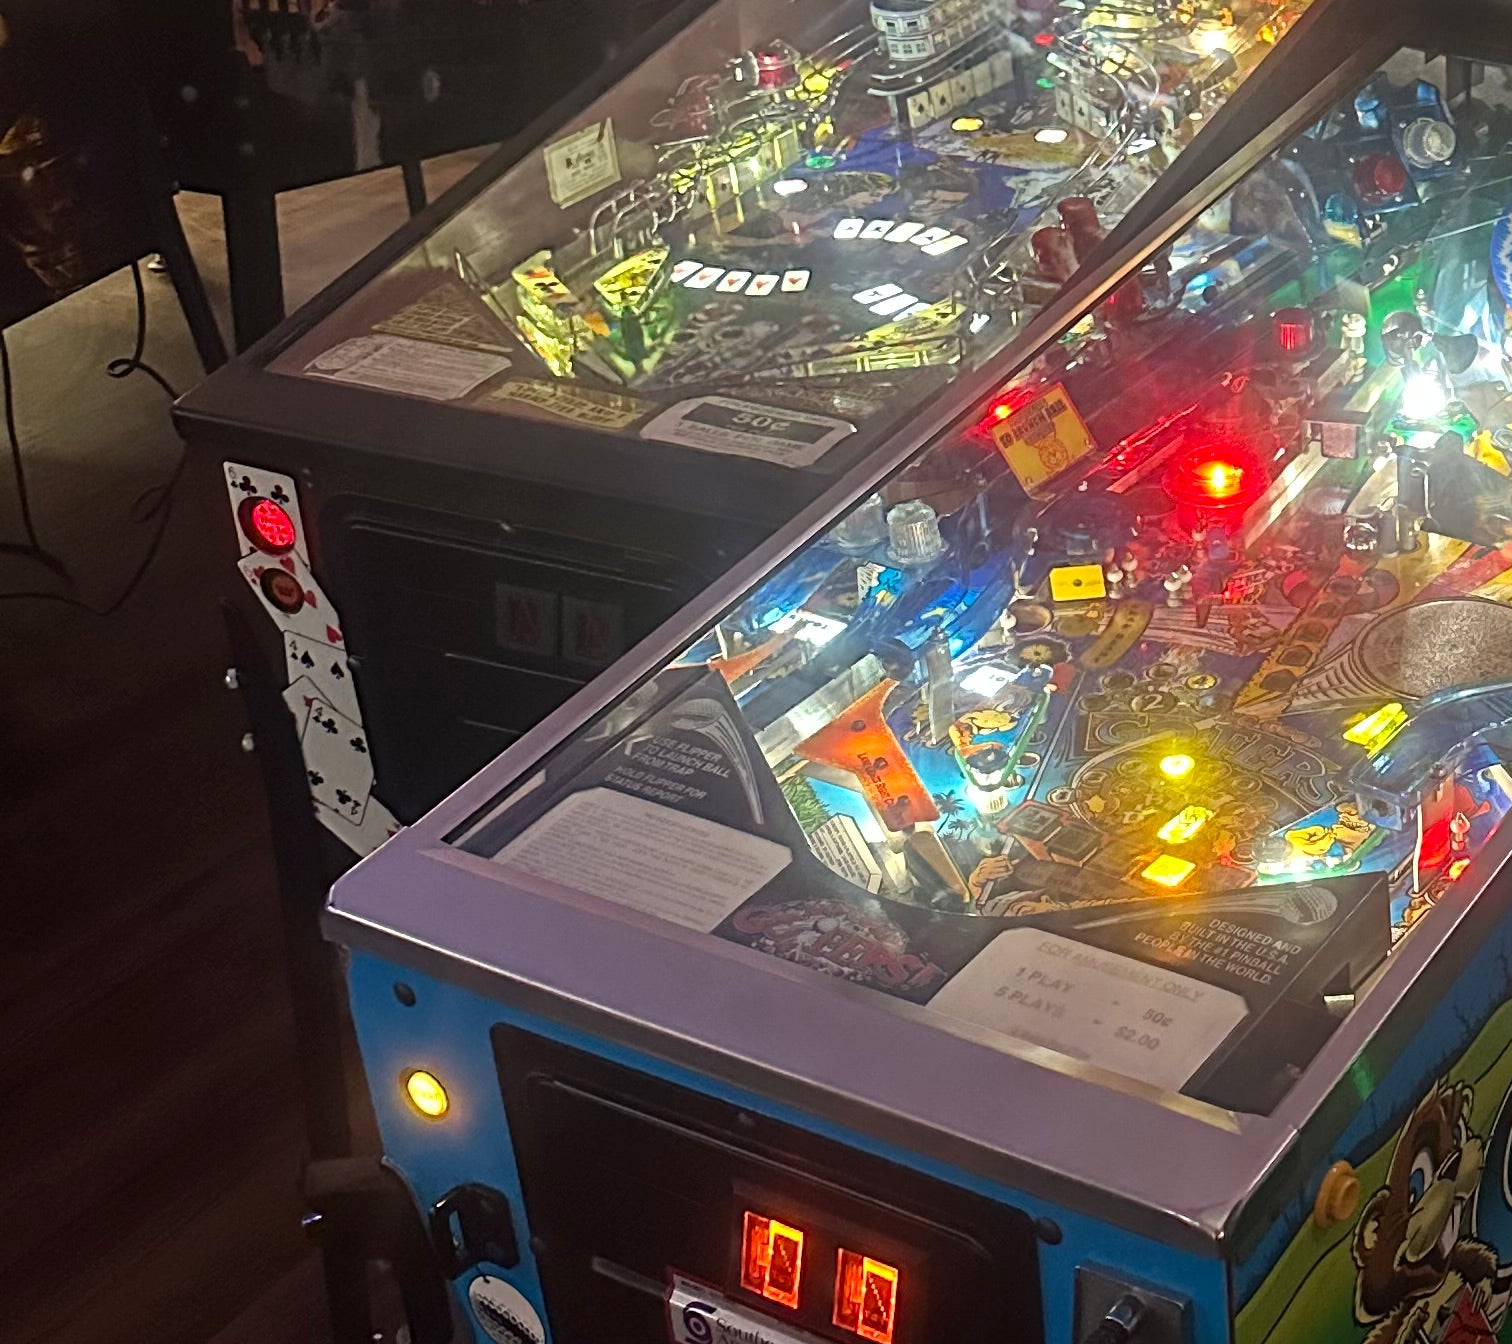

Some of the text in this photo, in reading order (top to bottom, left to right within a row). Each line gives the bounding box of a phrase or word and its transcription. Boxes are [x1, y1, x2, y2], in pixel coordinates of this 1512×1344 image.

[732, 412, 792, 432] 50¢
[632, 752, 694, 775] FROM TRAP
[643, 744, 731, 778] TO LAUNCH BALL
[653, 736, 722, 762] USE FLIPPER
[604, 773, 684, 803] STATUS REPORT
[642, 774, 687, 792] FLIPPER
[1168, 930, 1187, 943] BY
[1187, 936, 1214, 953] THE
[1229, 950, 1282, 976] PINBALL
[1179, 921, 1216, 940] BUILT
[1215, 931, 1228, 944] IN
[1230, 936, 1256, 953] THE
[1209, 918, 1303, 956] DESIGNED AND
[1133, 932, 1186, 957] PEOPLE
[1200, 954, 1226, 969] THE
[1224, 961, 1273, 985] WORLD.
[1027, 969, 1075, 994] PLAY
[1141, 1008, 1173, 1028] 50¢
[1161, 978, 1206, 1003] ONLY
[1007, 989, 1067, 1019] PLAYS
[1114, 1026, 1161, 1051] $2.00
